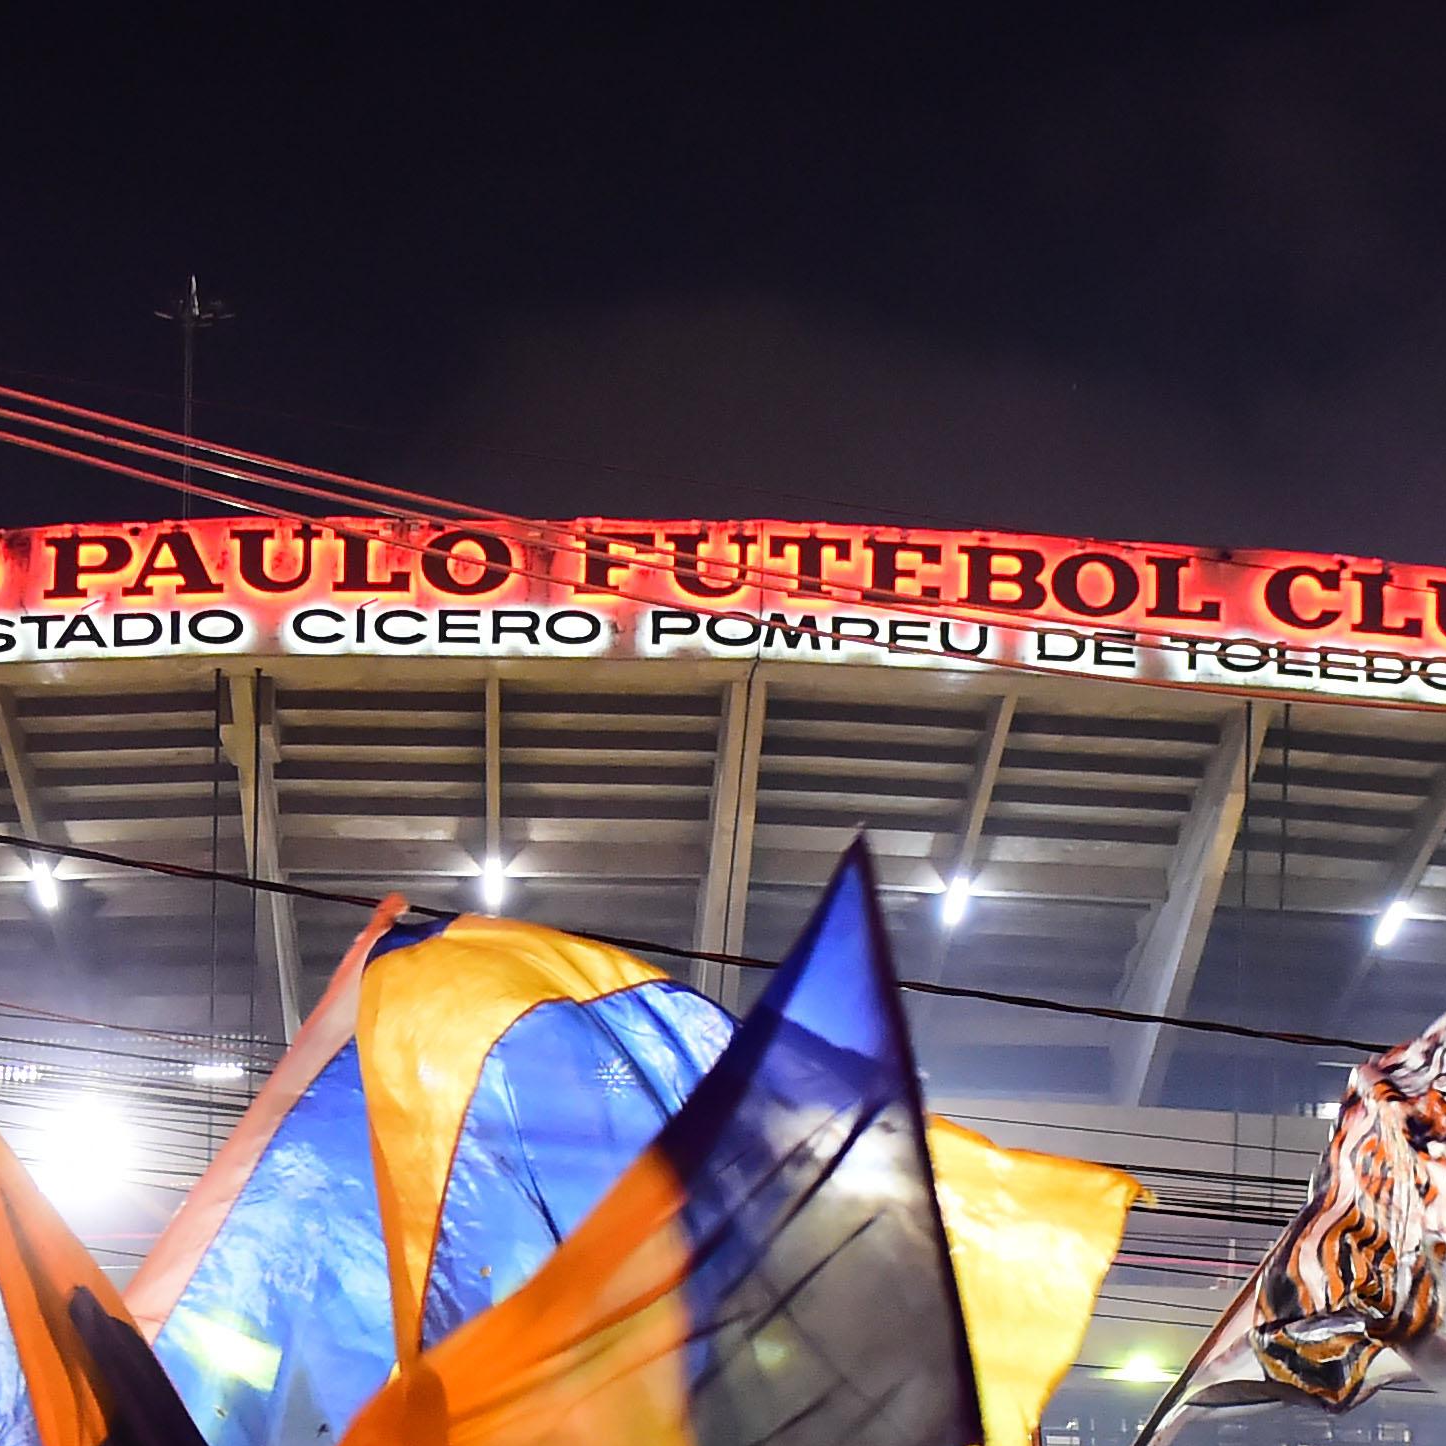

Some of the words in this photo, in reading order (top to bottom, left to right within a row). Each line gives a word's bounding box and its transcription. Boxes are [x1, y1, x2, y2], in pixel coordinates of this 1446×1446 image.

[43, 527, 512, 599] PAULO
[573, 531, 1221, 622] FUTEBOL
[292, 598, 601, 645] CÍCERO
[651, 610, 989, 655] POMPEU
[1036, 628, 1136, 668] DE
